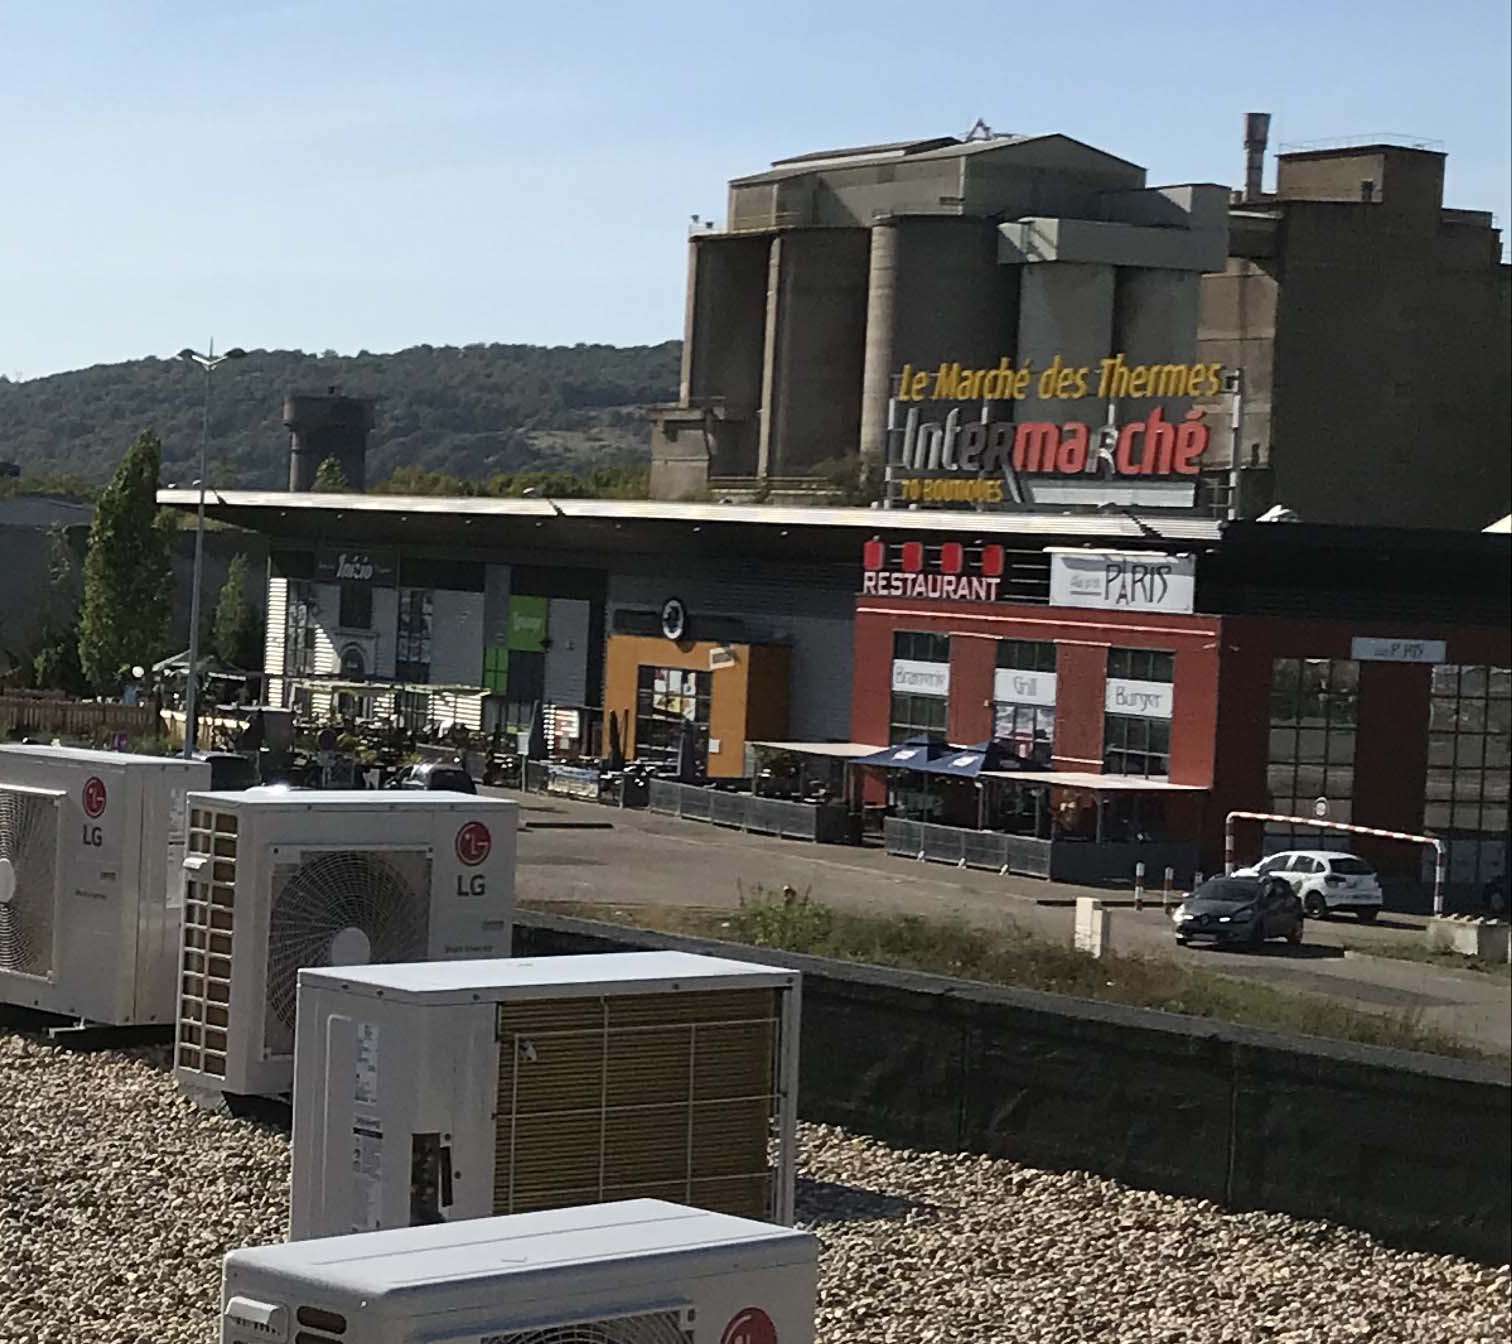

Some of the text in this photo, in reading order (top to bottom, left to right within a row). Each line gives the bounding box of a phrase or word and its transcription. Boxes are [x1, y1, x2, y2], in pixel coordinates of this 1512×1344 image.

[899, 353, 1222, 401] Le Marché des Thermes
[862, 571, 1001, 601] RESTAURANT
[1104, 558, 1172, 605] PARIS
[1115, 686, 1163, 712] Burger
[83, 824, 102, 847] LG
[457, 874, 486, 896] LG
